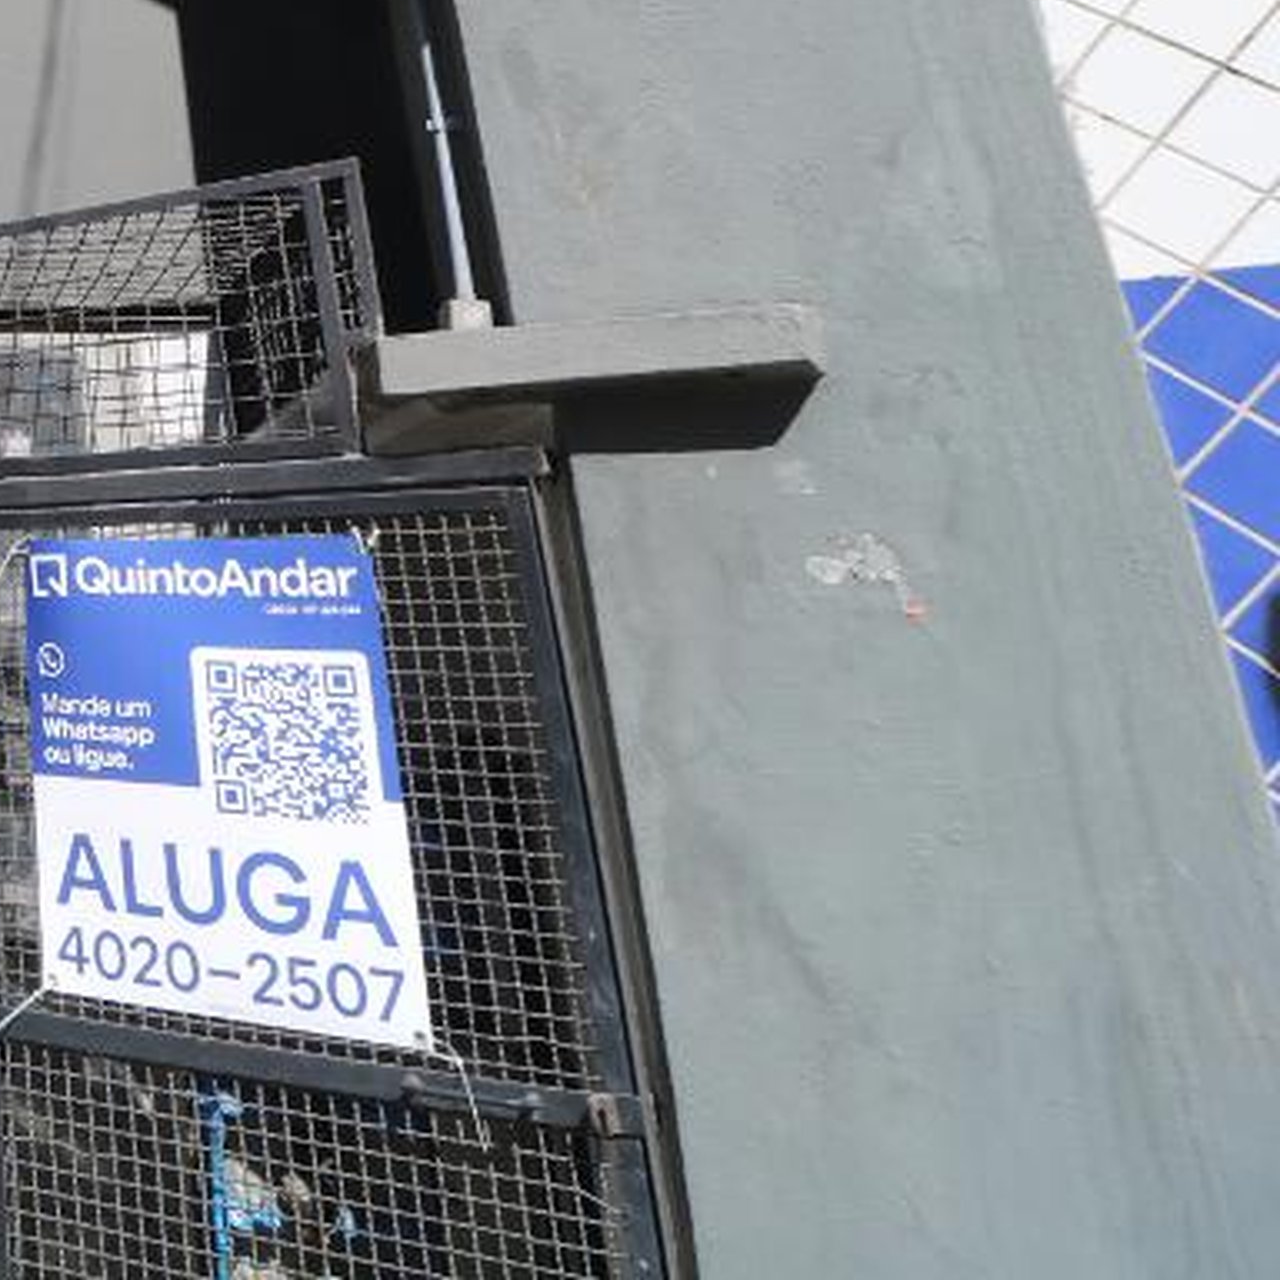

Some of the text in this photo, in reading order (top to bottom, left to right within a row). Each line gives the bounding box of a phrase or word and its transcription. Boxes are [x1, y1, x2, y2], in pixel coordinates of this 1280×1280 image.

[75, 556, 357, 597] QuintoAndar
[115, 699, 152, 718] um
[41, 716, 155, 748] Whatsapp
[43, 746, 71, 764] ou
[56, 832, 400, 948] ALUGA
[57, 925, 406, 1022] 4020-2507
